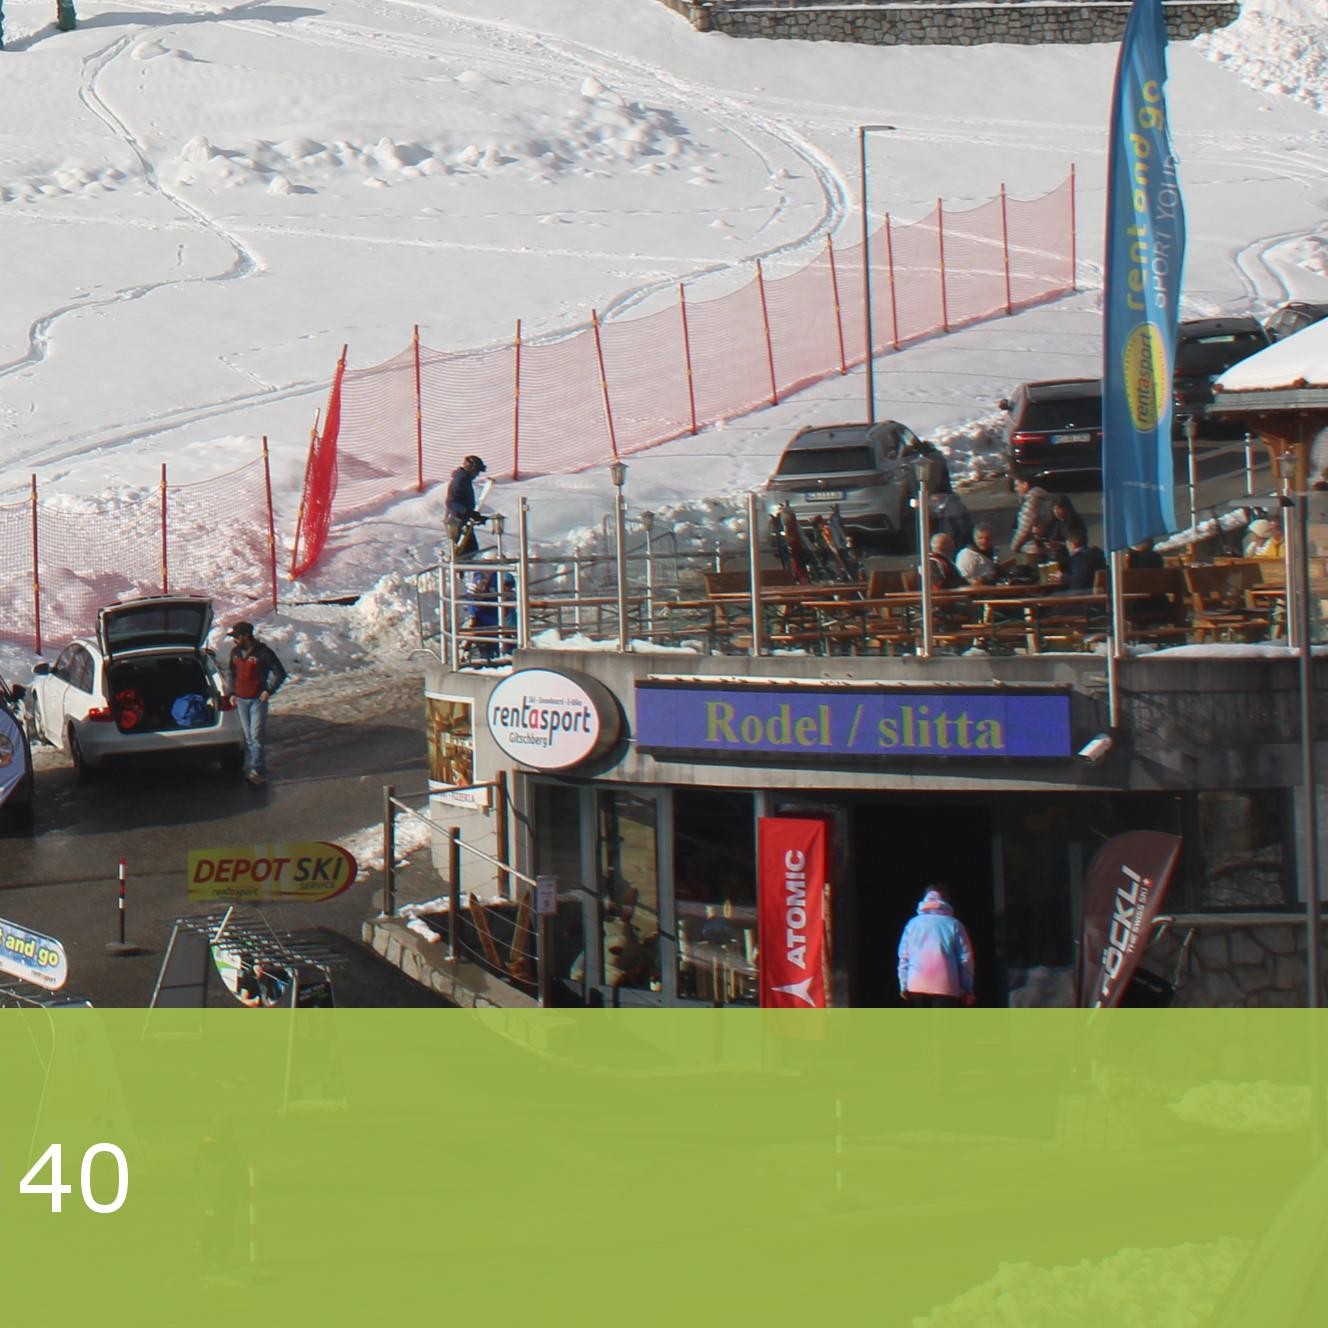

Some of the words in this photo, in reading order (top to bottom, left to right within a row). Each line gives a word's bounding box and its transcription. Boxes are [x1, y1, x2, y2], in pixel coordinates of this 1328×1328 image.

[1138, 79, 1164, 130] go
[1129, 133, 1151, 213] and
[1126, 224, 1149, 311] rent
[1152, 231, 1172, 309] SPORT
[1136, 332, 1153, 423] rentasport
[492, 695, 591, 746] rentasport
[508, 732, 548, 748] Gitschberg
[704, 700, 833, 746] Rodel
[846, 703, 864, 747] /
[878, 705, 1006, 749] slitta
[193, 857, 290, 884] DEPOT
[293, 856, 344, 882] SKI
[784, 849, 807, 970] ATOMIC
[1095, 864, 1142, 1008] ÖCKLI
[4, 934, 37, 959] and
[37, 946, 61, 968] go
